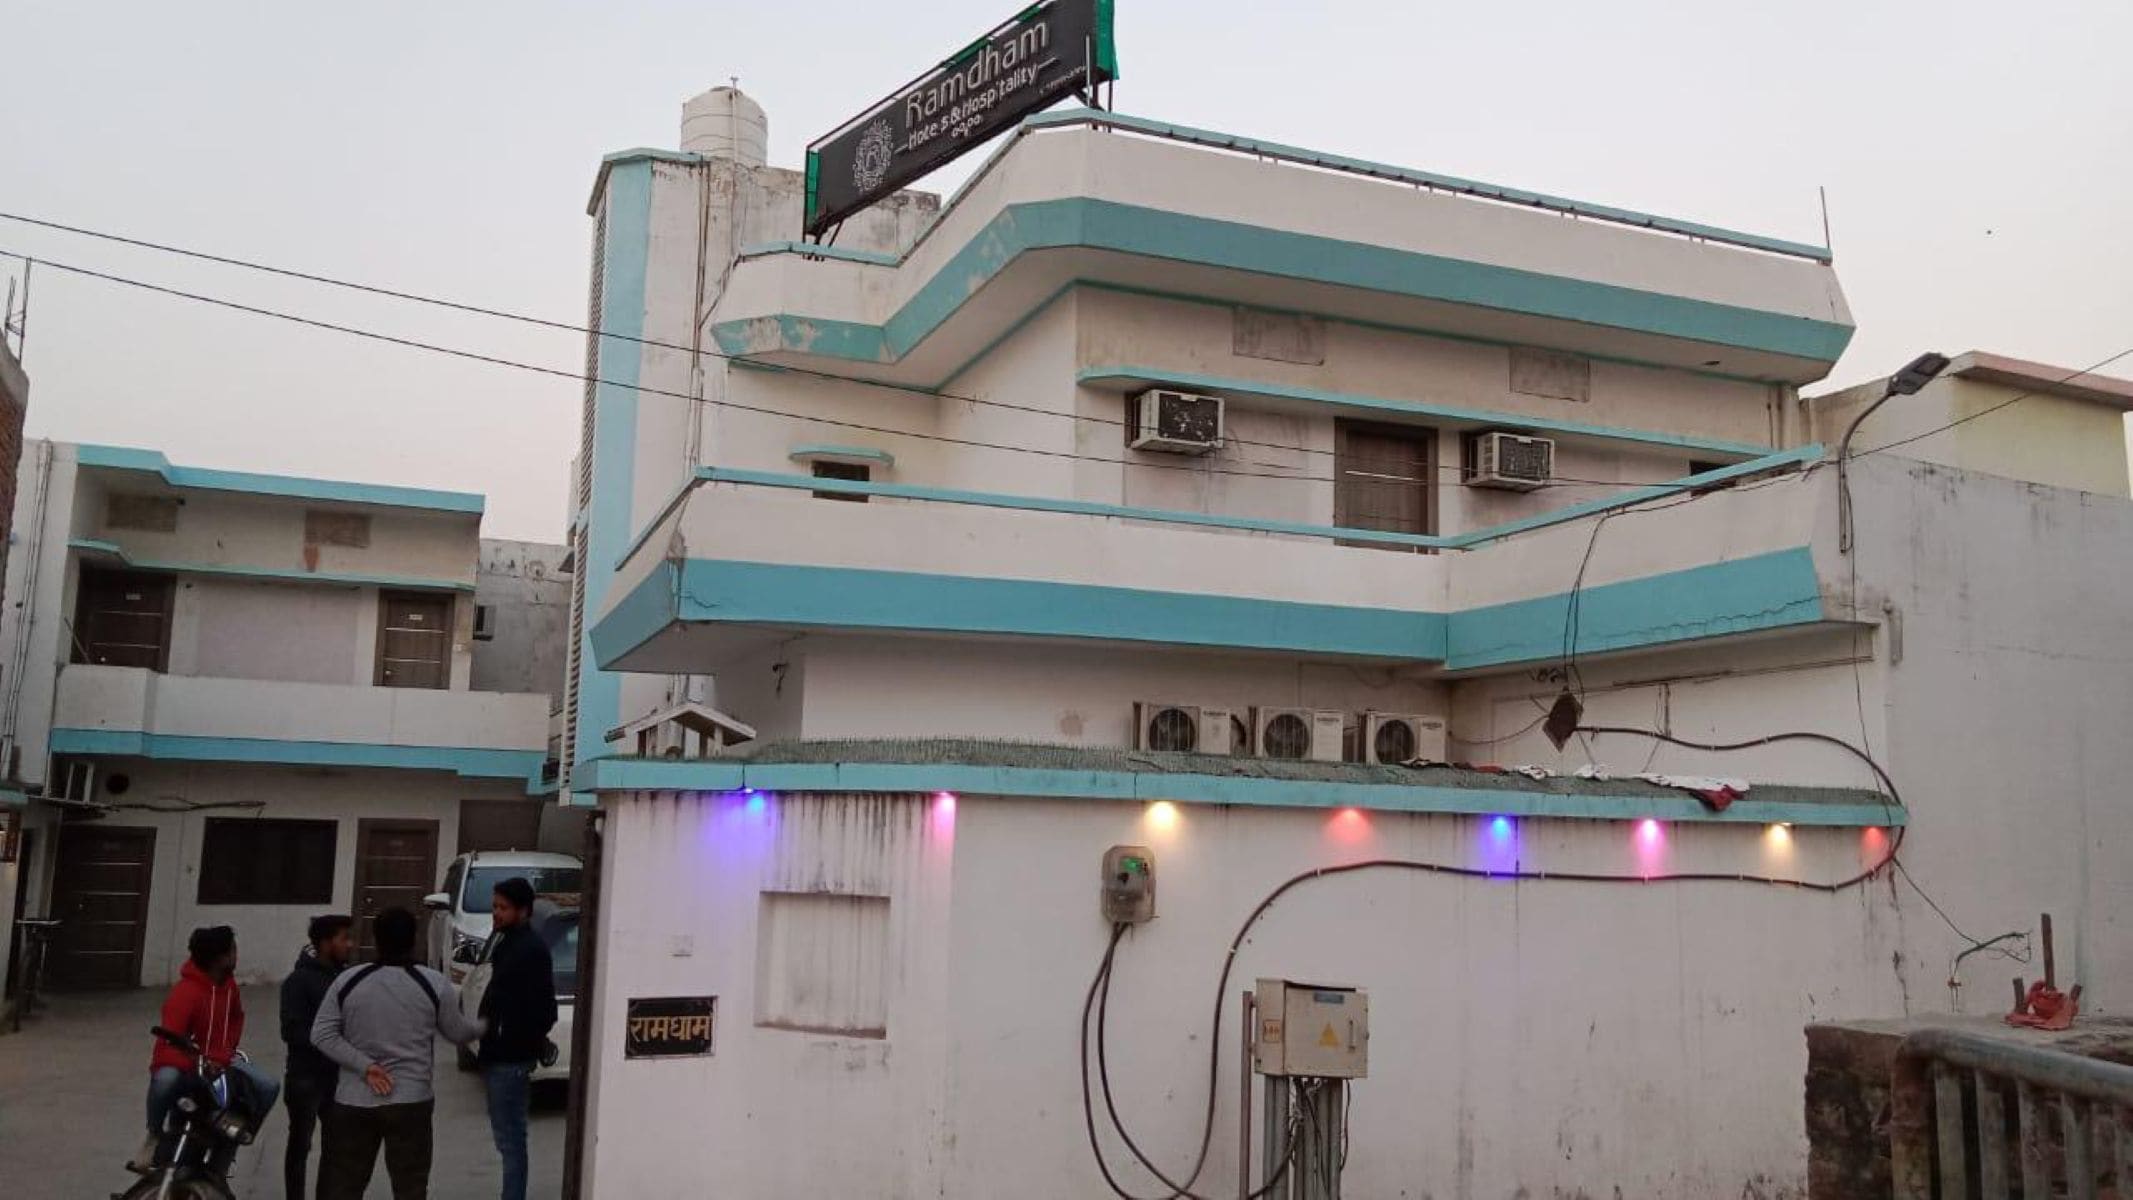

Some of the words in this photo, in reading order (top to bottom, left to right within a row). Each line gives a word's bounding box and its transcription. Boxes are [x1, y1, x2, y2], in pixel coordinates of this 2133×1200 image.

[905, 22, 1046, 129] Ramdham
[908, 114, 950, 151] Hotes
[630, 1015, 711, 1042] रामधाम
